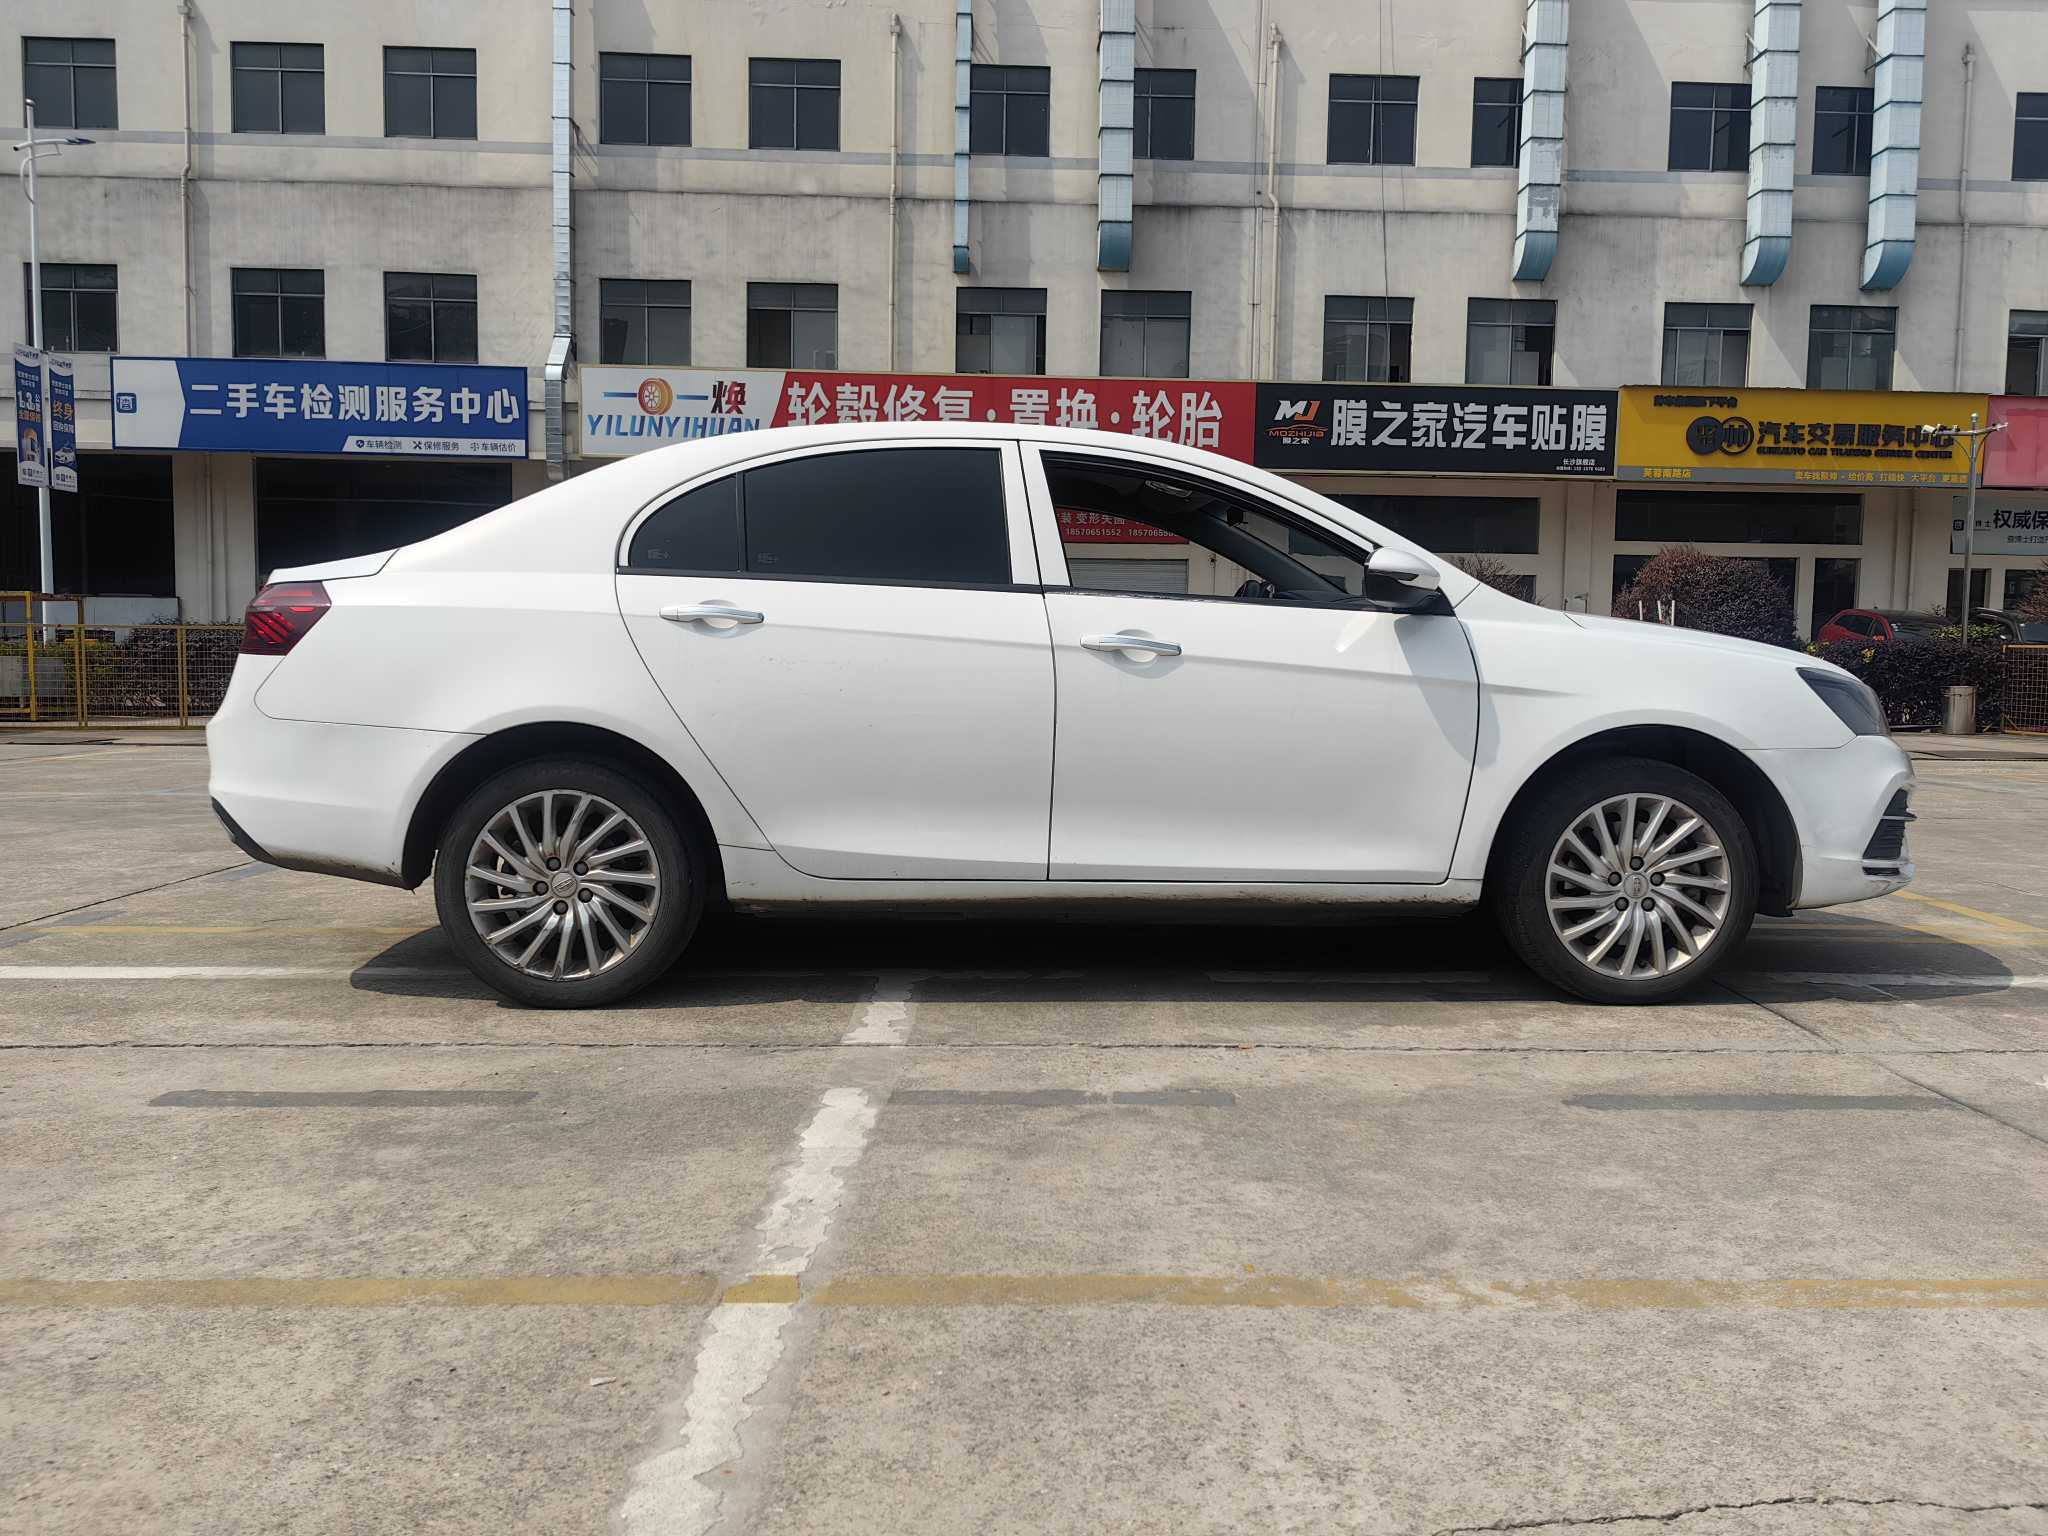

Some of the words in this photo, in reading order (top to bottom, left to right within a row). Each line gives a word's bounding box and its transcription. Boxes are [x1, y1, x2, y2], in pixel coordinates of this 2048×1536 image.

[190, 383, 520, 424] 二手车检测服务中心
[1273, 400, 1320, 421] MJ
[1330, 399, 1607, 451] 膜之家汽车贴膜
[1757, 421, 1954, 449] 汽车交易服务中心
[365, 440, 401, 450] 车辆检测
[423, 441, 460, 452] 保修服务
[482, 443, 517, 454] 车辆估价
[1066, 528, 1121, 537] 18570651552
